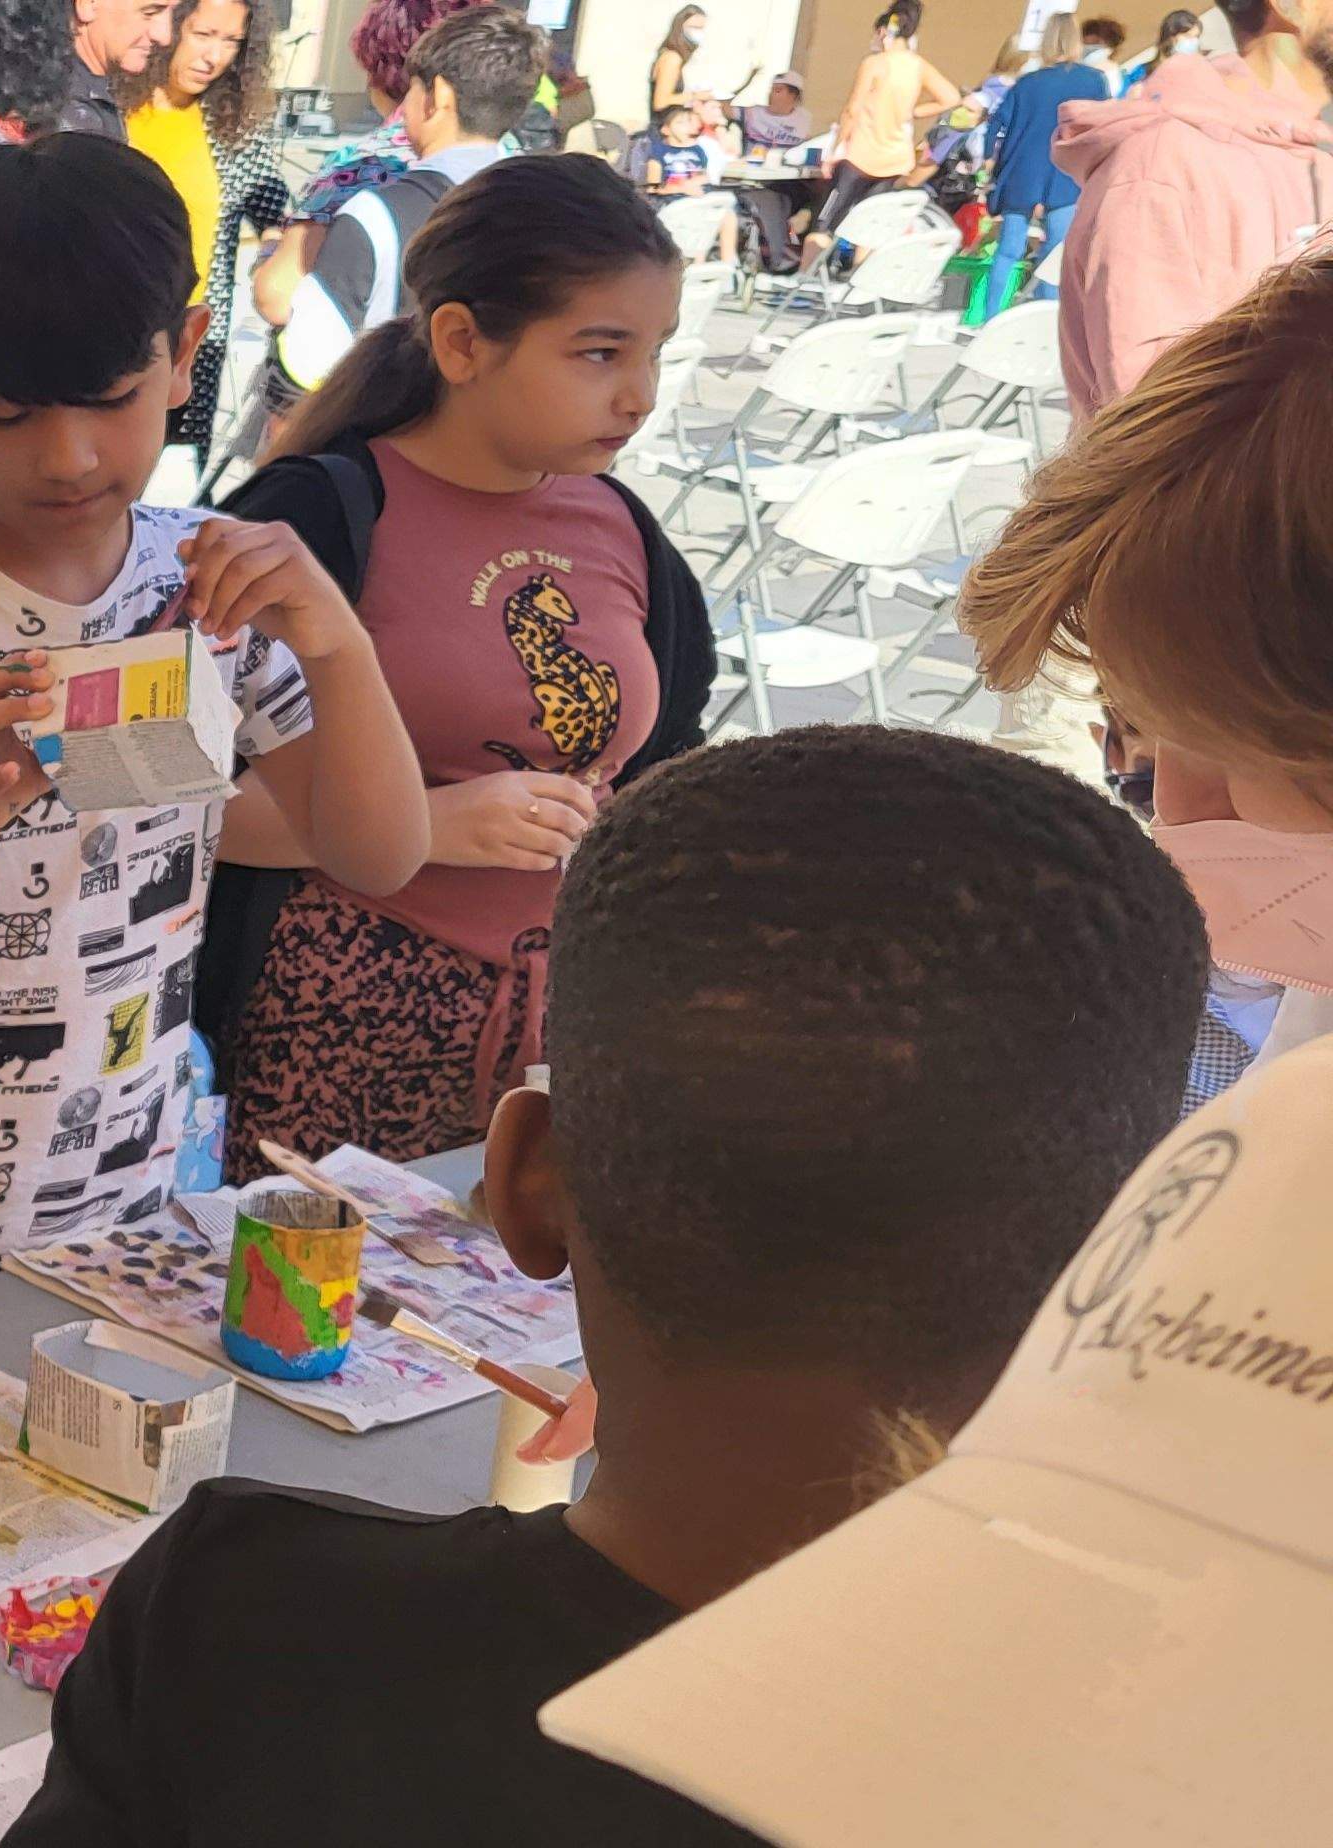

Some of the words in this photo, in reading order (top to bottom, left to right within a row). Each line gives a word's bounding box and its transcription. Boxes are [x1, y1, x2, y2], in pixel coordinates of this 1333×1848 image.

[469, 560, 502, 608] WALK
[500, 549, 531, 570] ON
[532, 550, 574, 575] THE
